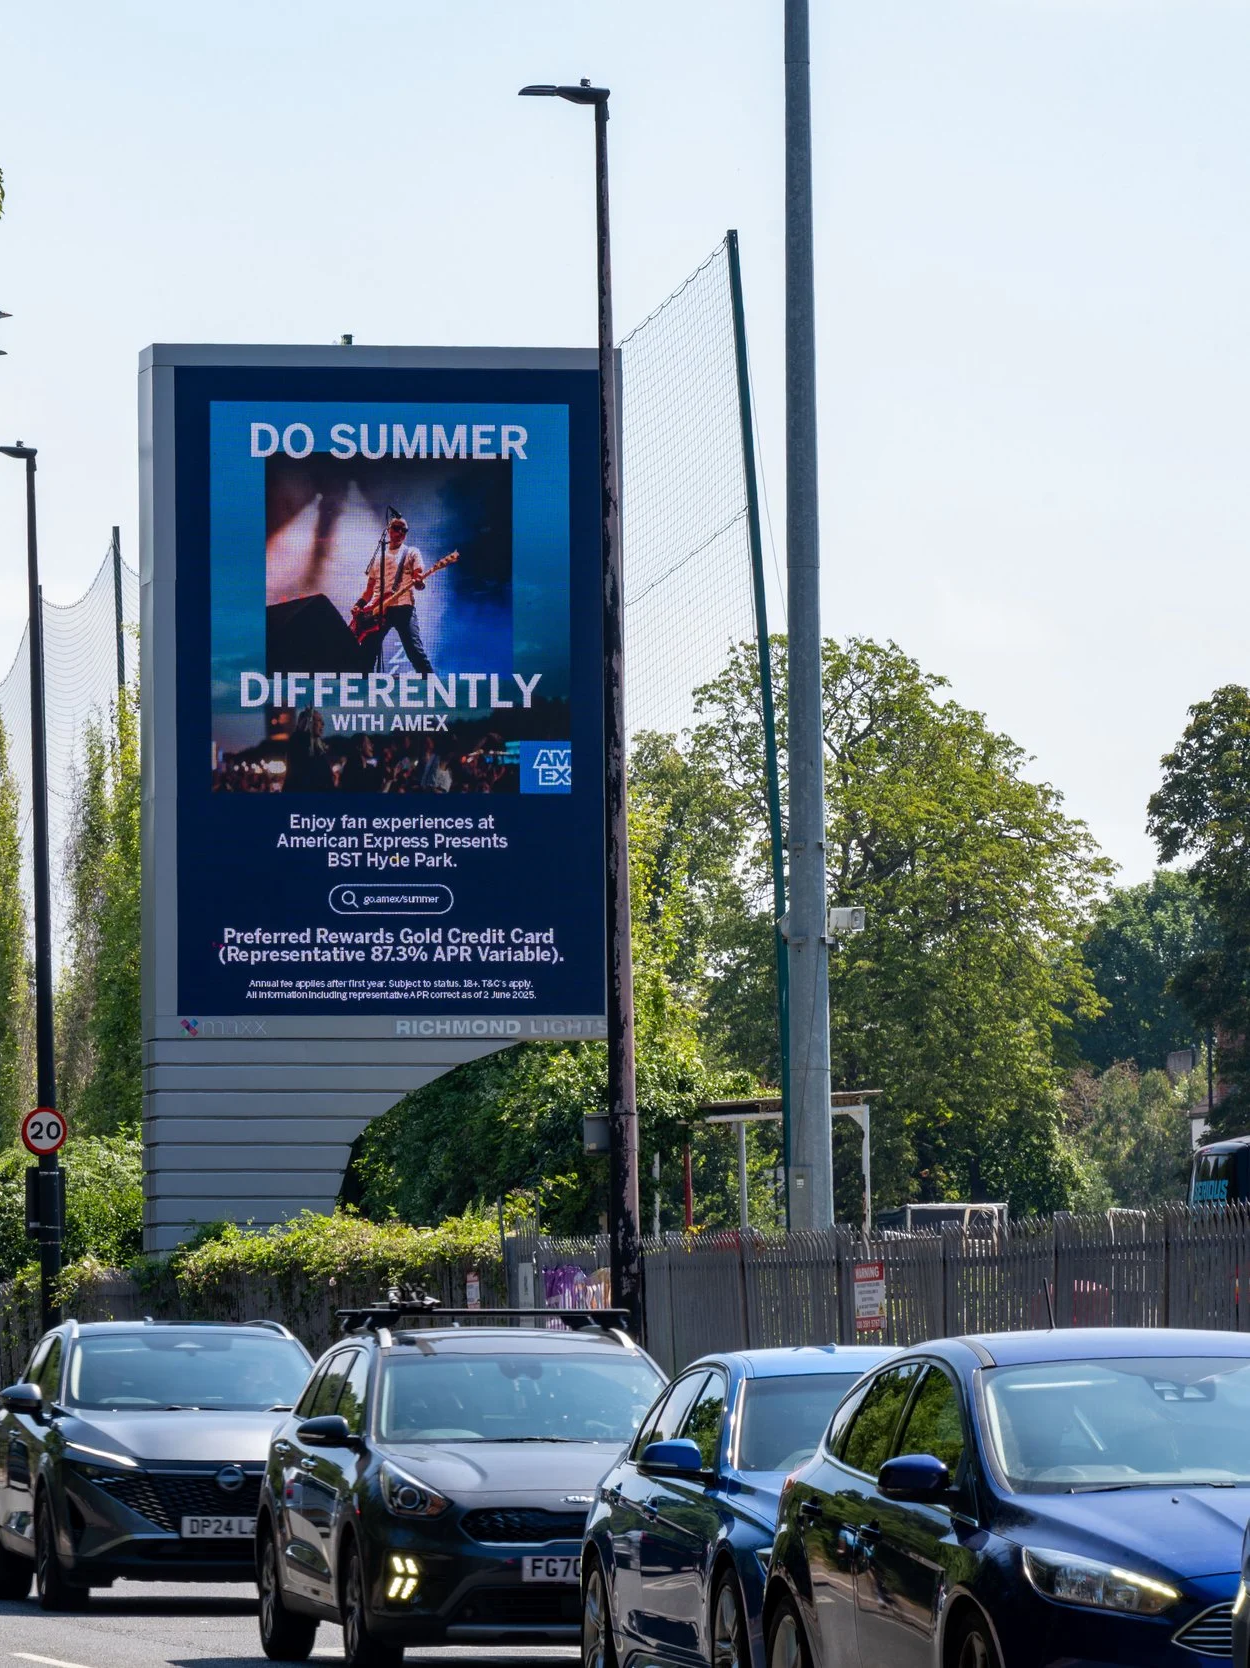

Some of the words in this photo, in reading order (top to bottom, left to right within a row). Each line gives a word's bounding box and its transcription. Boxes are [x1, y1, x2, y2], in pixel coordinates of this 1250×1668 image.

[250, 422, 315, 459] DO
[329, 423, 528, 461] SUMMER
[240, 671, 543, 708] DIFFERENTLY
[331, 714, 384, 731] WITH
[390, 714, 448, 731] AMEX
[290, 814, 336, 832] Enjoy
[340, 814, 367, 829] fan
[372, 814, 473, 832] experiences
[478, 815, 495, 829] at
[276, 833, 359, 849] American
[363, 833, 429, 852] Express
[435, 833, 508, 849] Presents
[327, 852, 362, 867] BST
[366, 852, 410, 869] Hyde
[415, 852, 457, 867] Park.
[363, 895, 439, 905] go.amex/summer
[224, 928, 311, 944] Preferred
[316, 928, 394, 944] Rewards
[399, 928, 442, 944] Gold
[447, 928, 505, 944] Credit
[510, 928, 554, 944] Card
[218, 946, 366, 965] (Representative
[370, 946, 428, 962] 87.3%
[433, 946, 472, 962] APR
[477, 946, 565, 964] Variable).
[249, 980, 279, 988] Annual
[280, 980, 293, 988] fee
[295, 980, 325, 990] applies
[327, 980, 348, 988] after
[348, 980, 365, 988] first
[366, 980, 387, 990] year.
[388, 980, 421, 990] Subject
[422, 980, 431, 988] to
[433, 980, 462, 988] status.
[463, 980, 481, 988] 18+.
[508, 980, 534, 990] apply.
[246, 991, 257, 999] All
[349, 991, 409, 1001] representative
[409, 991, 429, 999] APR
[430, 991, 460, 999] correct
[473, 991, 483, 999] of
[483, 991, 489, 999] 2
[491, 991, 511, 999] June
[512, 991, 537, 999] 2025.
[395, 1020, 521, 1035] RICHMOND
[530, 1020, 607, 1034] LIGHTS
[30, 1121, 61, 1140] 20
[1195, 1180, 1229, 1200] SERIOUS
[855, 1266, 879, 1279] WARNING
[189, 1518, 234, 1535] DP24
